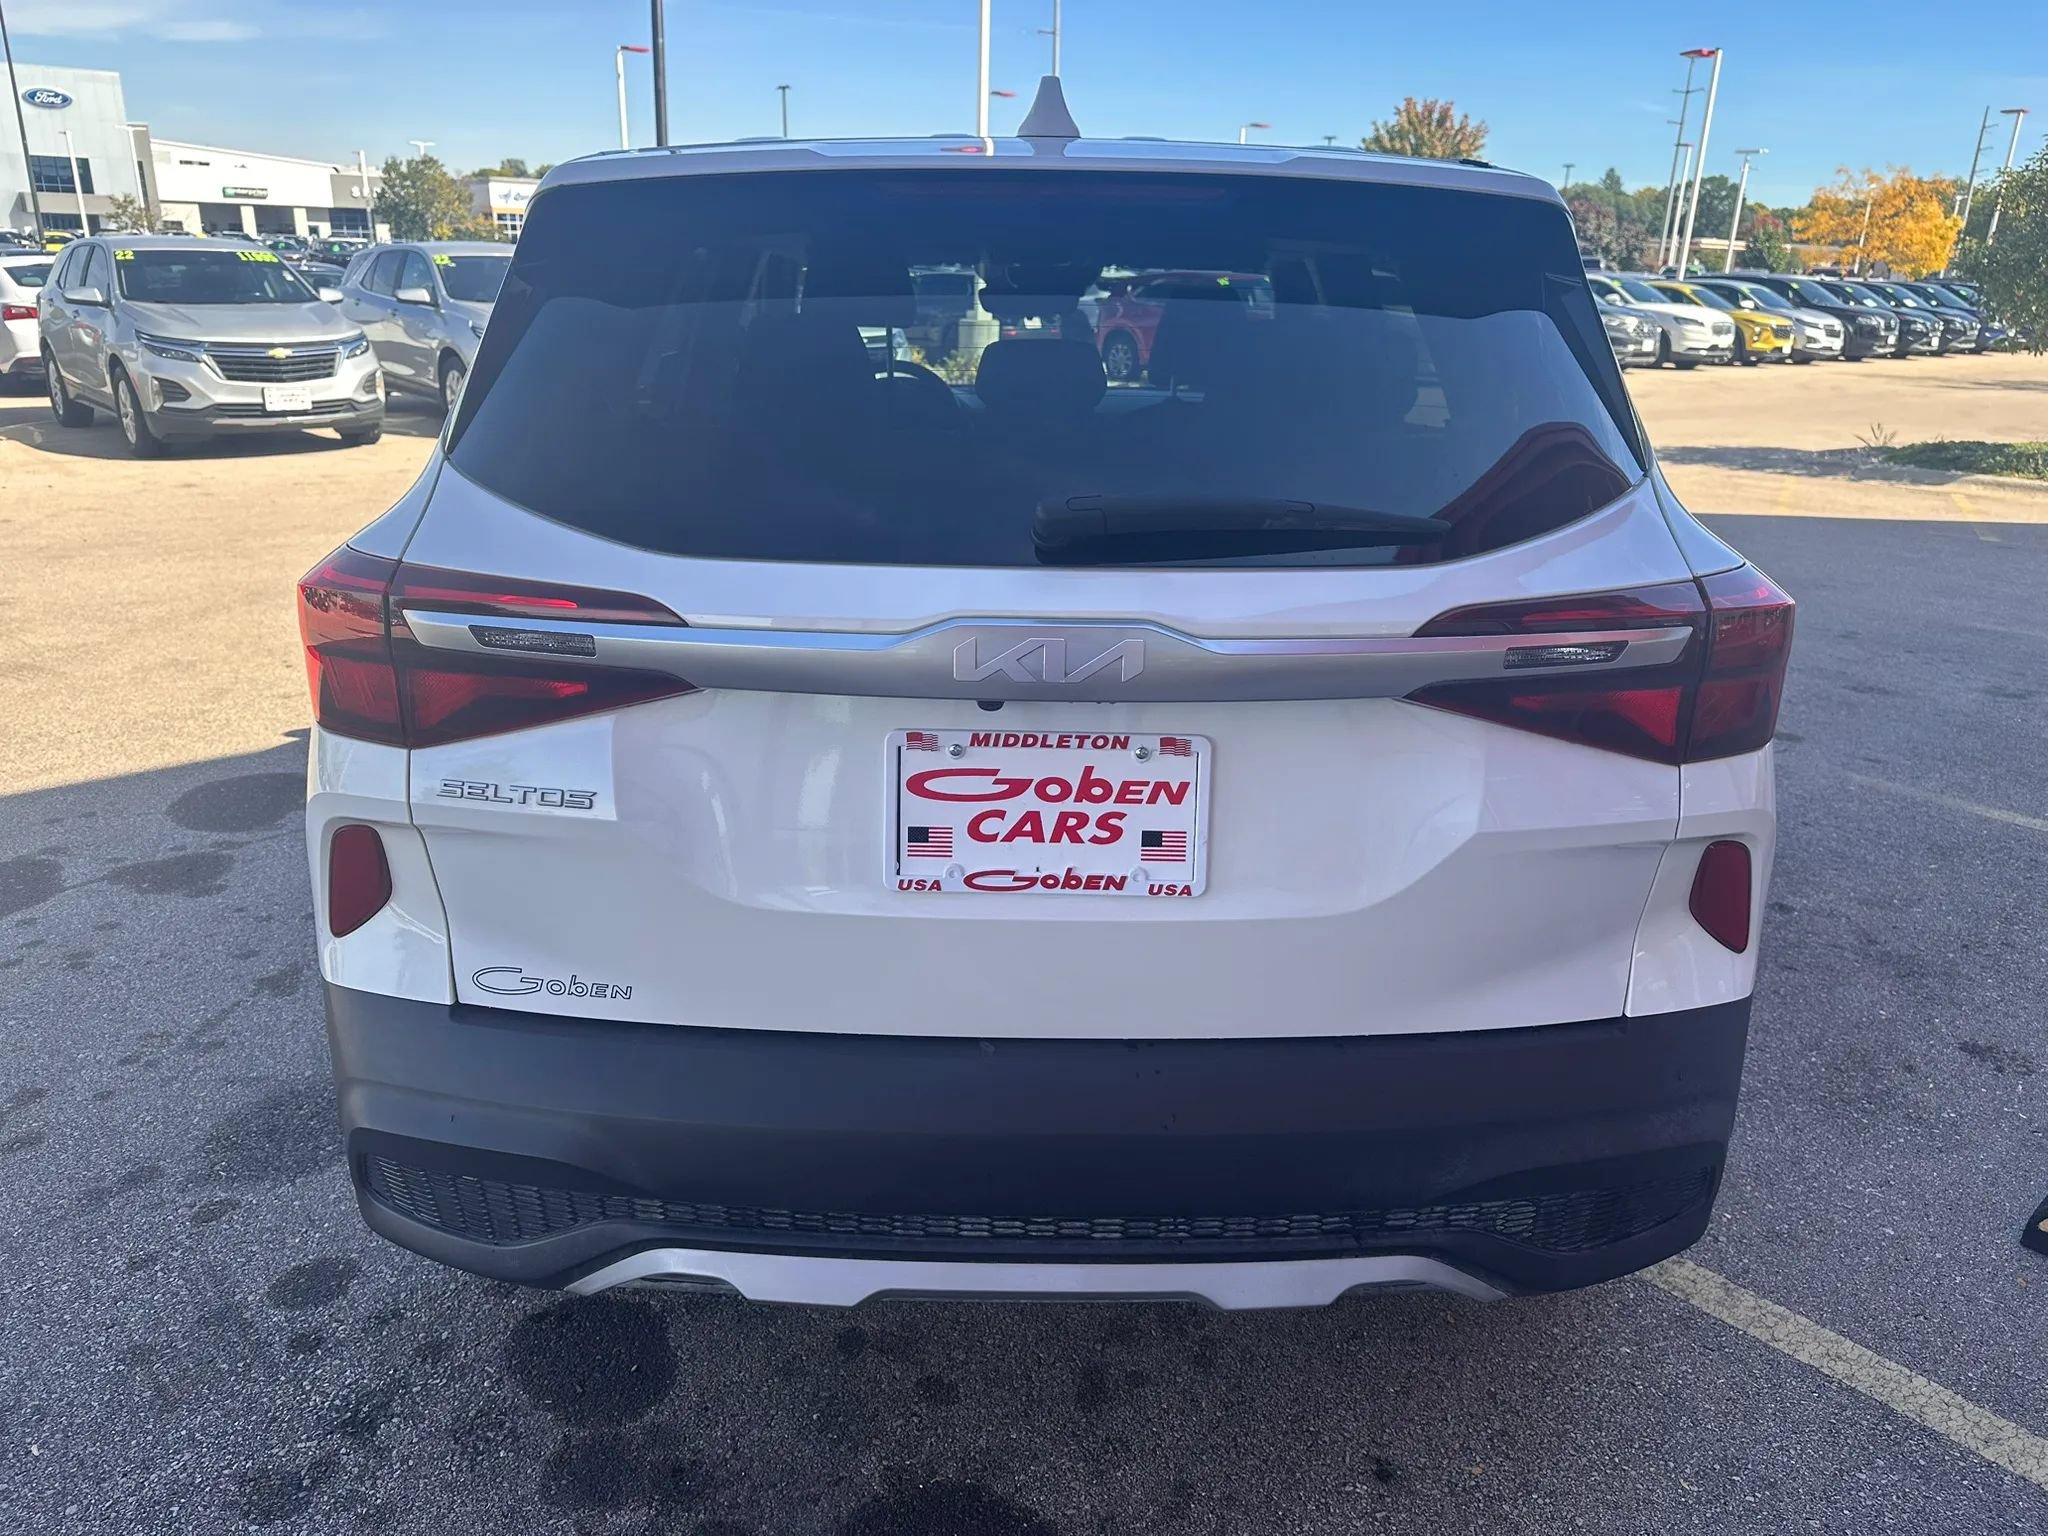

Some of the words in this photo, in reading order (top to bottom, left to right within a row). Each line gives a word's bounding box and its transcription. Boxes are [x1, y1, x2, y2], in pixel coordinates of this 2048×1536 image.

[34, 91, 63, 104] Ford
[953, 636, 1144, 683] KIA
[969, 732, 1131, 750] MIDDLETON
[435, 778, 598, 810] SELTOS
[966, 808, 1128, 846] CARS
[897, 879, 942, 892] USA
[1148, 883, 1193, 897] USA
